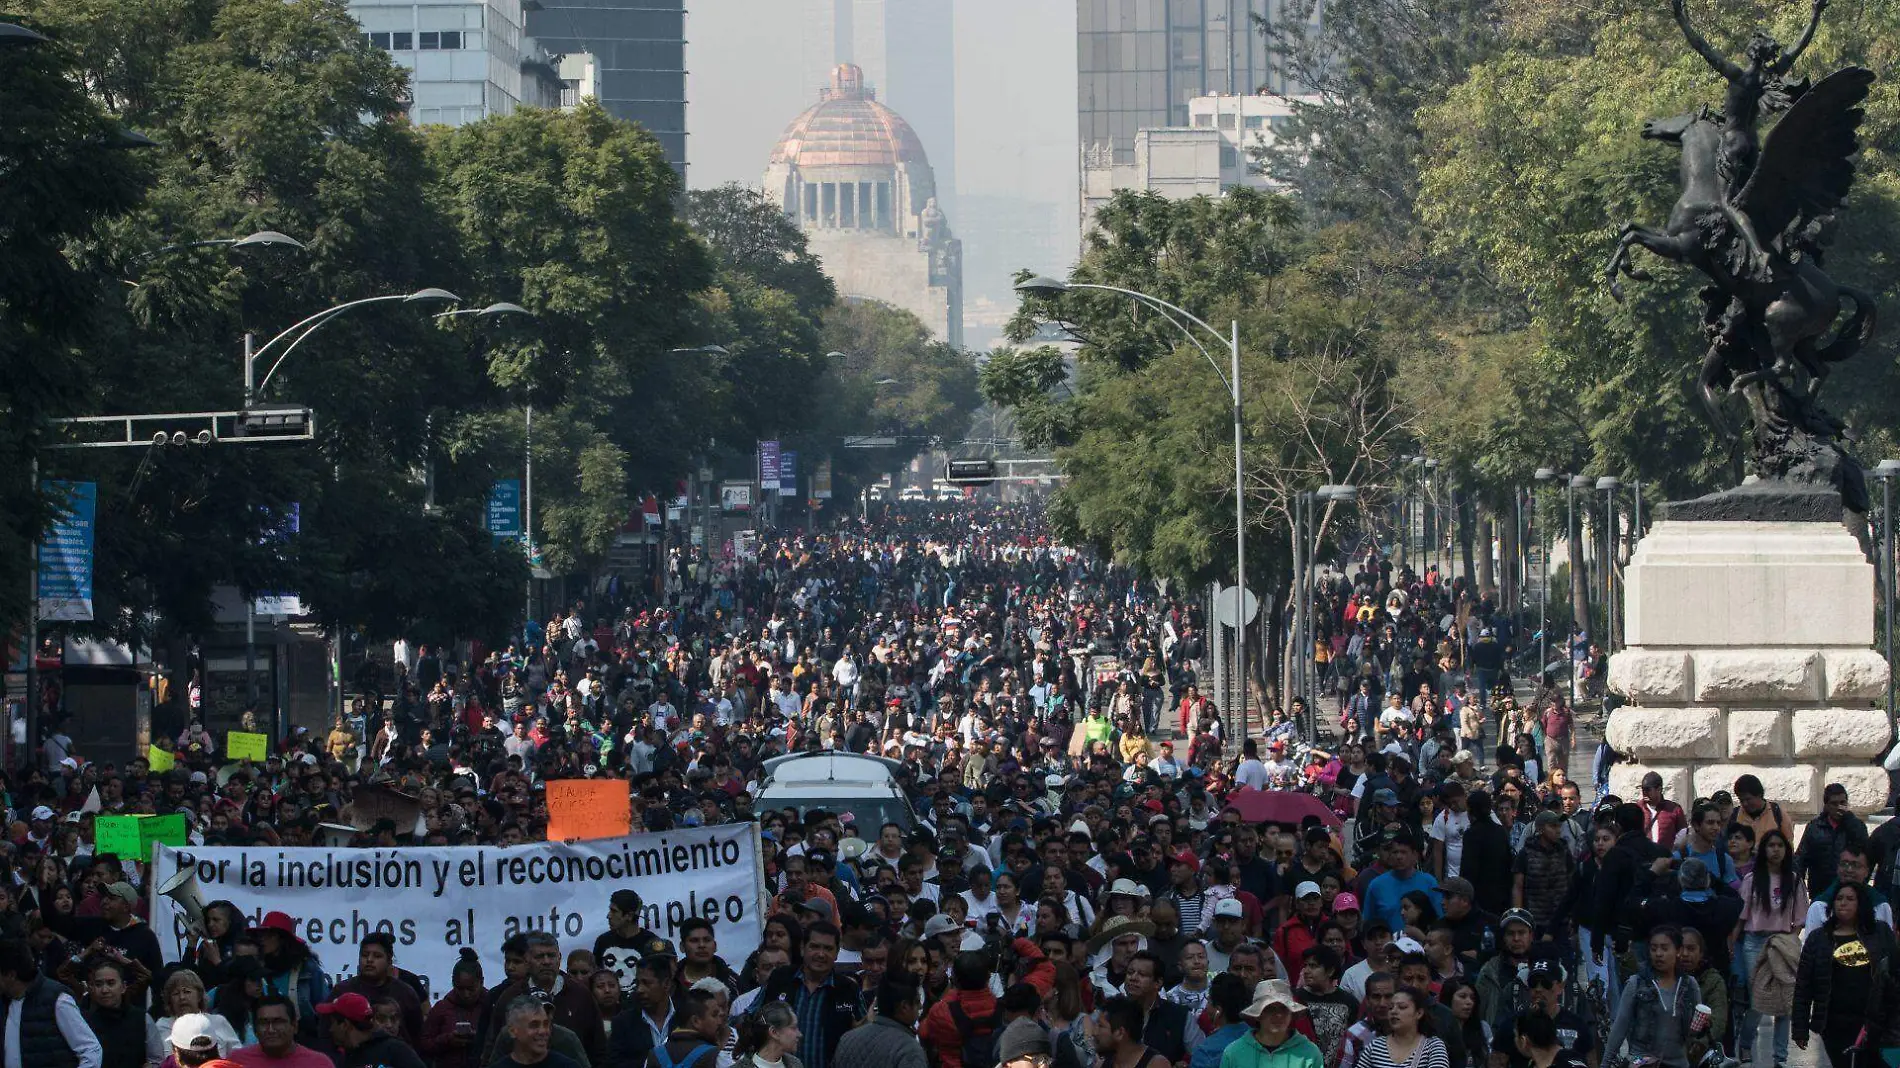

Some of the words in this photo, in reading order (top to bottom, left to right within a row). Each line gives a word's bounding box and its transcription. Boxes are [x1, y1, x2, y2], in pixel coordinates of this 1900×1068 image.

[176, 850, 231, 884] Por
[241, 851, 266, 887] la
[277, 849, 421, 888] inclusión
[432, 860, 450, 898] y
[458, 850, 485, 887] el
[496, 835, 740, 885] reconocimiento
[246, 906, 418, 946] drechos
[445, 908, 475, 945] al
[504, 905, 583, 940] auto
[640, 890, 744, 938] mpleo
